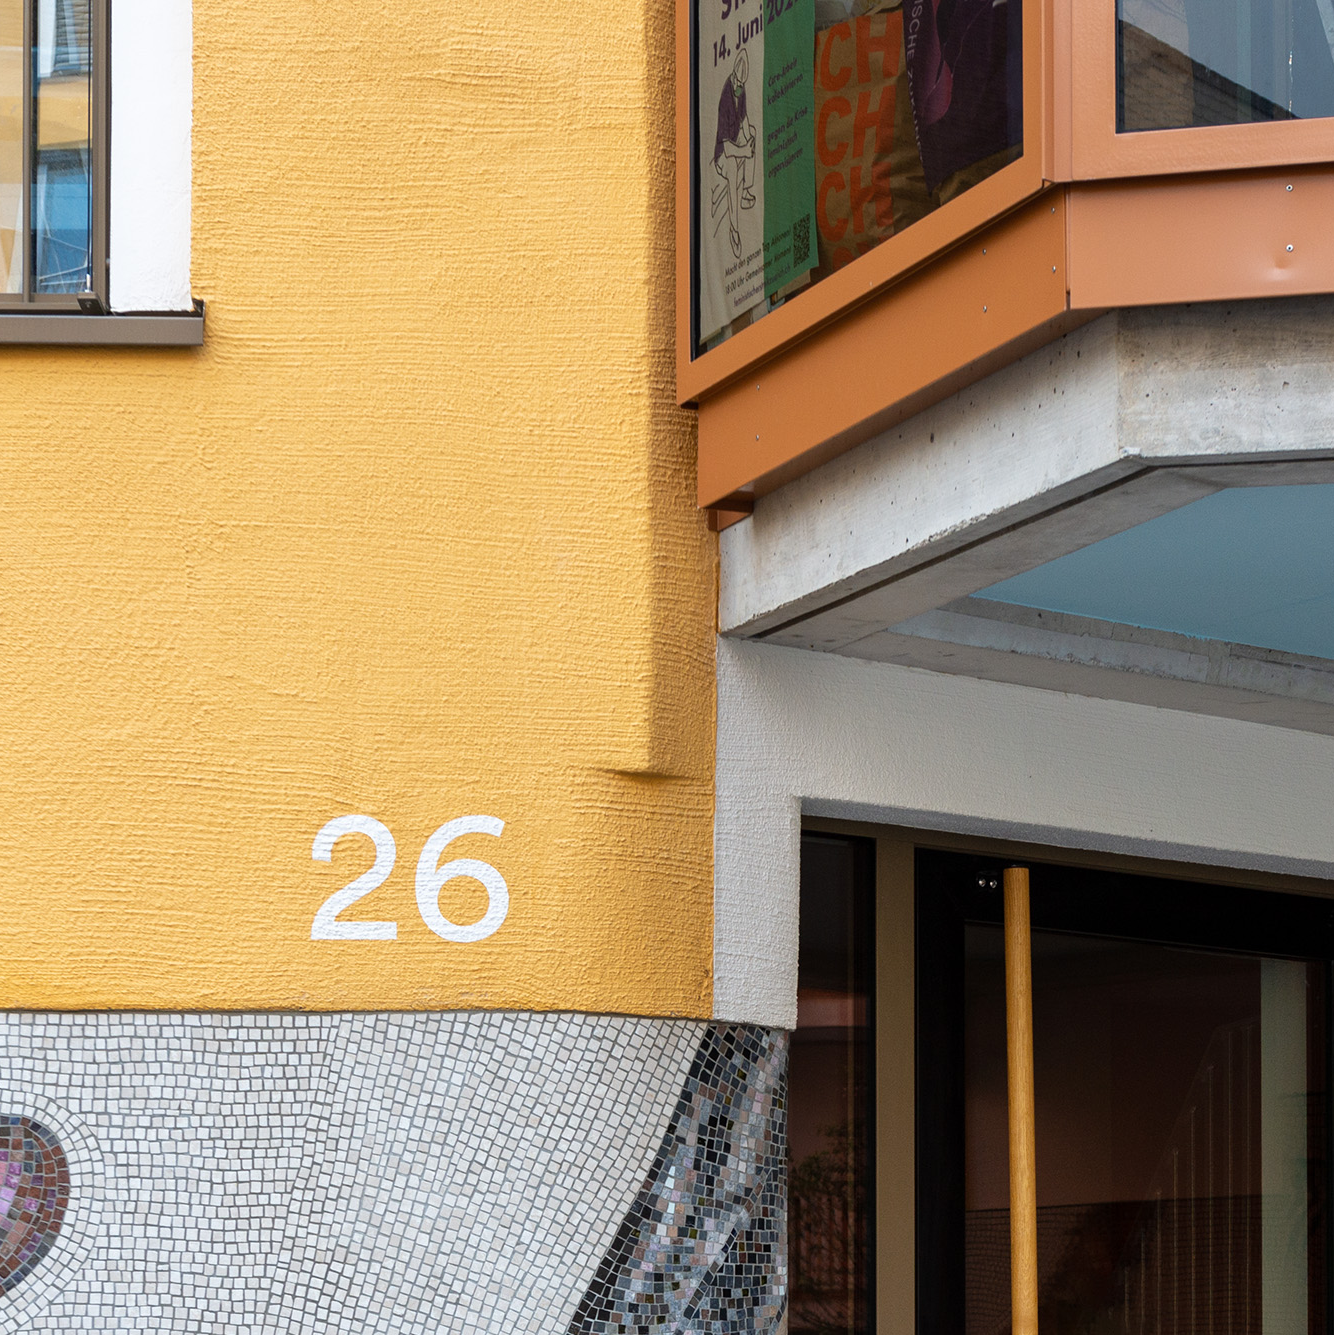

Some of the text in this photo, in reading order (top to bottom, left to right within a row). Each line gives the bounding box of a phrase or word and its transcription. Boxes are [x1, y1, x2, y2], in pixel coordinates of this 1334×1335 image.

[714, 34, 731, 67] 14.
[736, 3, 763, 50] Juni
[311, 814, 509, 942] 26
